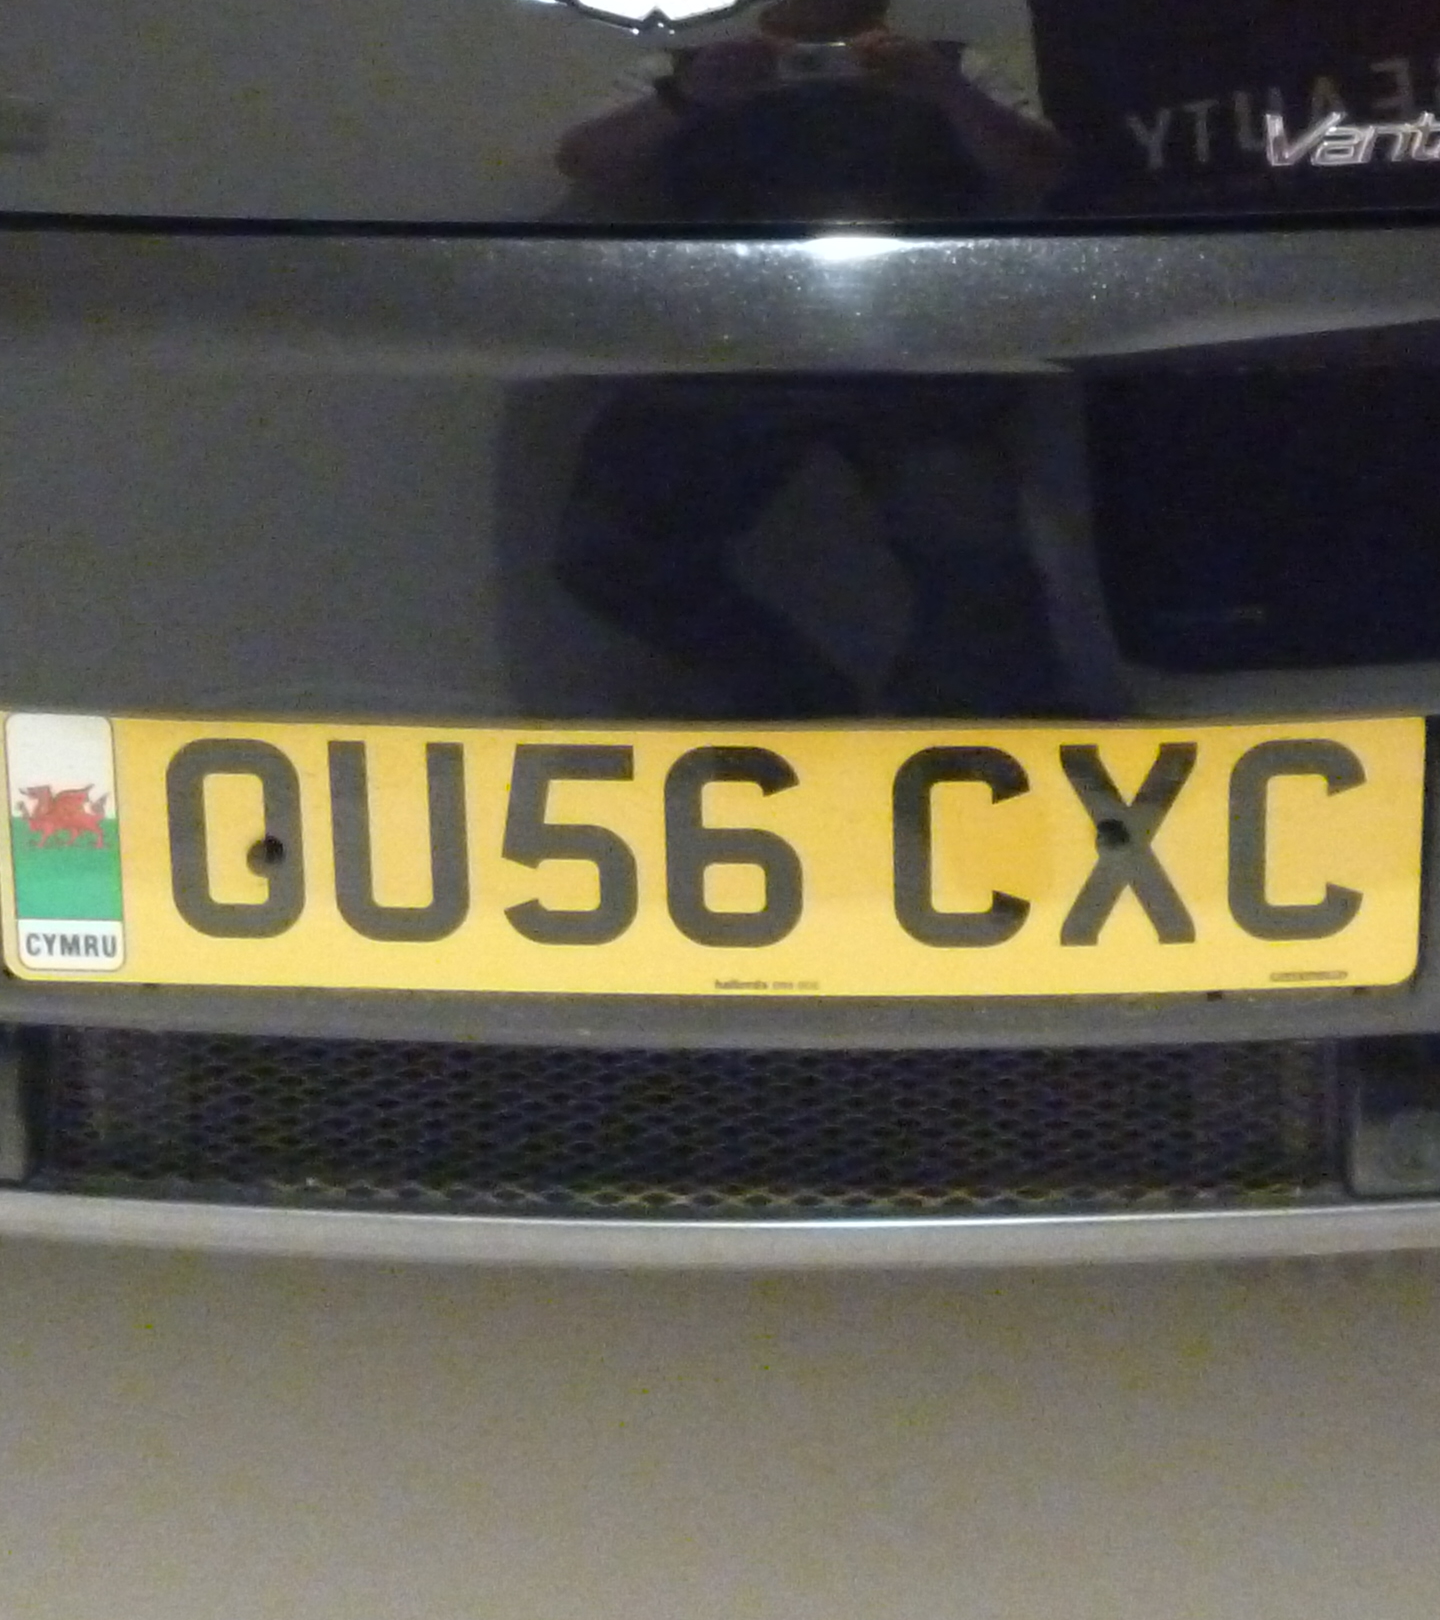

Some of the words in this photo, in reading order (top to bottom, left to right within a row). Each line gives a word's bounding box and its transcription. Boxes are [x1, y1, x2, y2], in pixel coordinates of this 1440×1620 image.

[166, 738, 804, 948] OU56
[892, 738, 1367, 949] CXC
[25, 932, 118, 958] CYMRU
